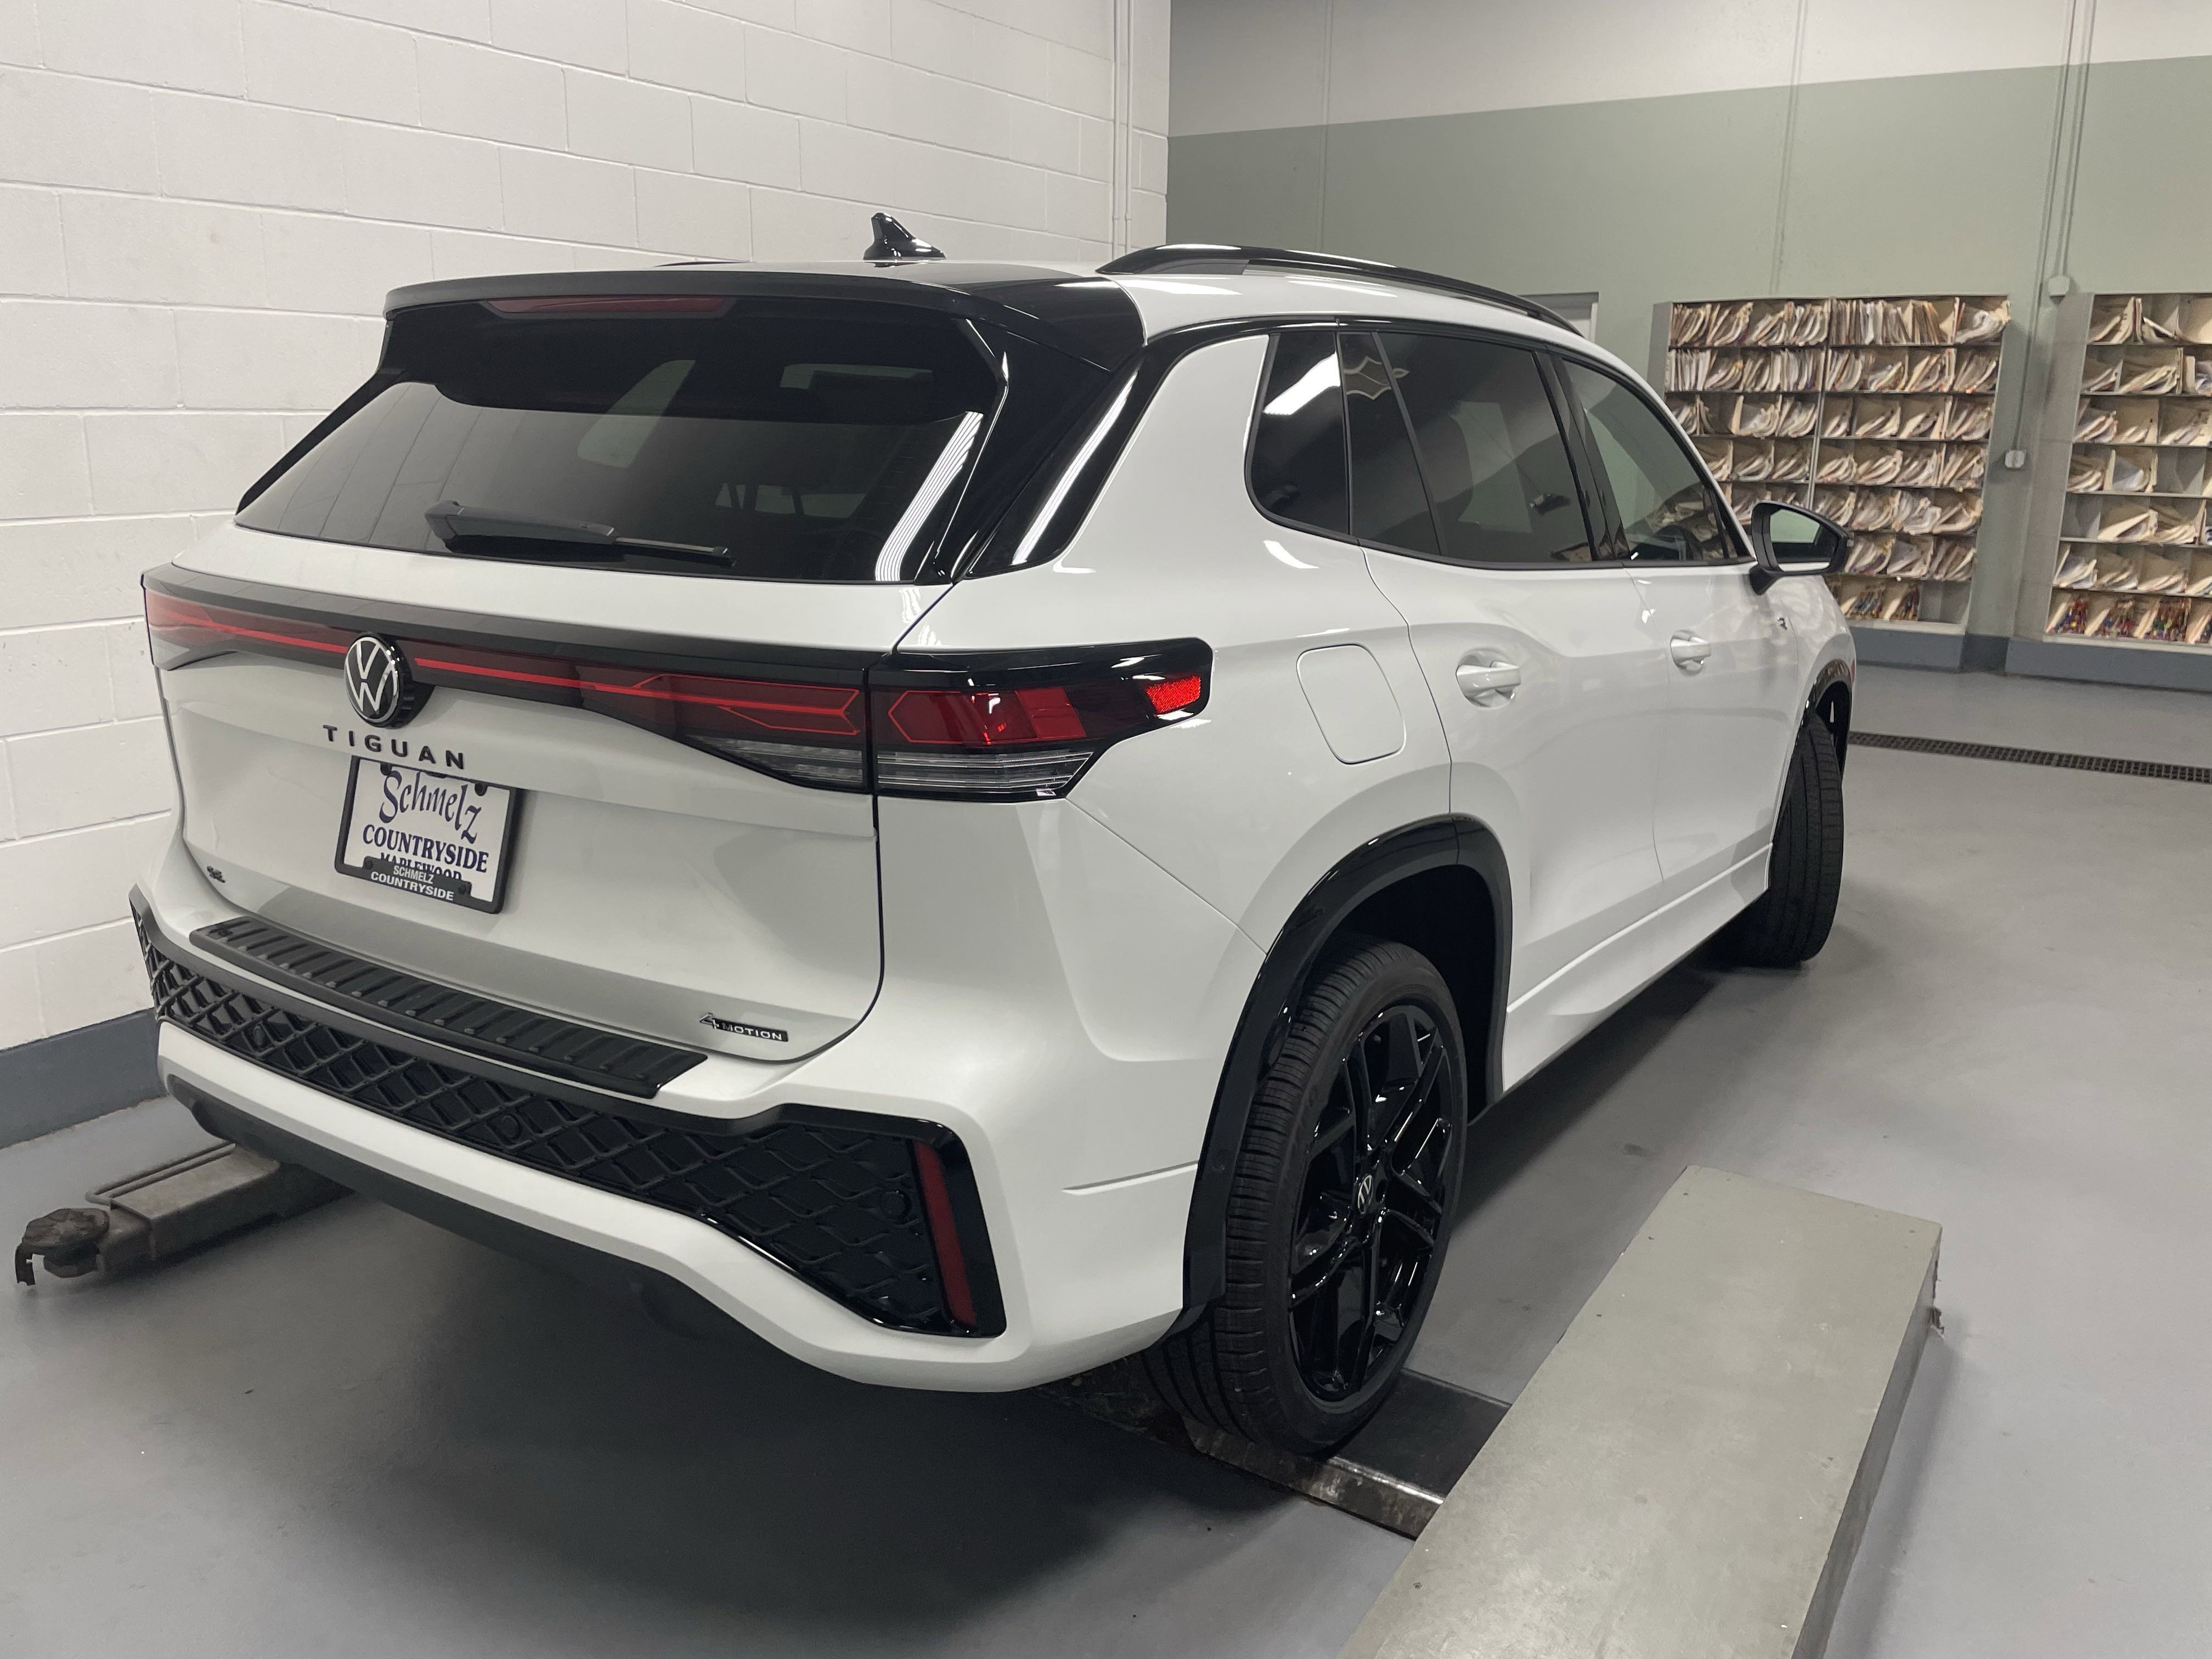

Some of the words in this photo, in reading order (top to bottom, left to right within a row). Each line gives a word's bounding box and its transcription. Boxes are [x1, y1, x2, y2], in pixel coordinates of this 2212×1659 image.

[323, 725, 465, 770] TIGUAN
[379, 770, 482, 844] Schmelz
[363, 824, 489, 873] COUNTRYSIDE
[370, 871, 455, 901] COUNTRYSIDE
[393, 865, 435, 884] SCHMELZ
[699, 1013, 782, 1041] 4MOTION
